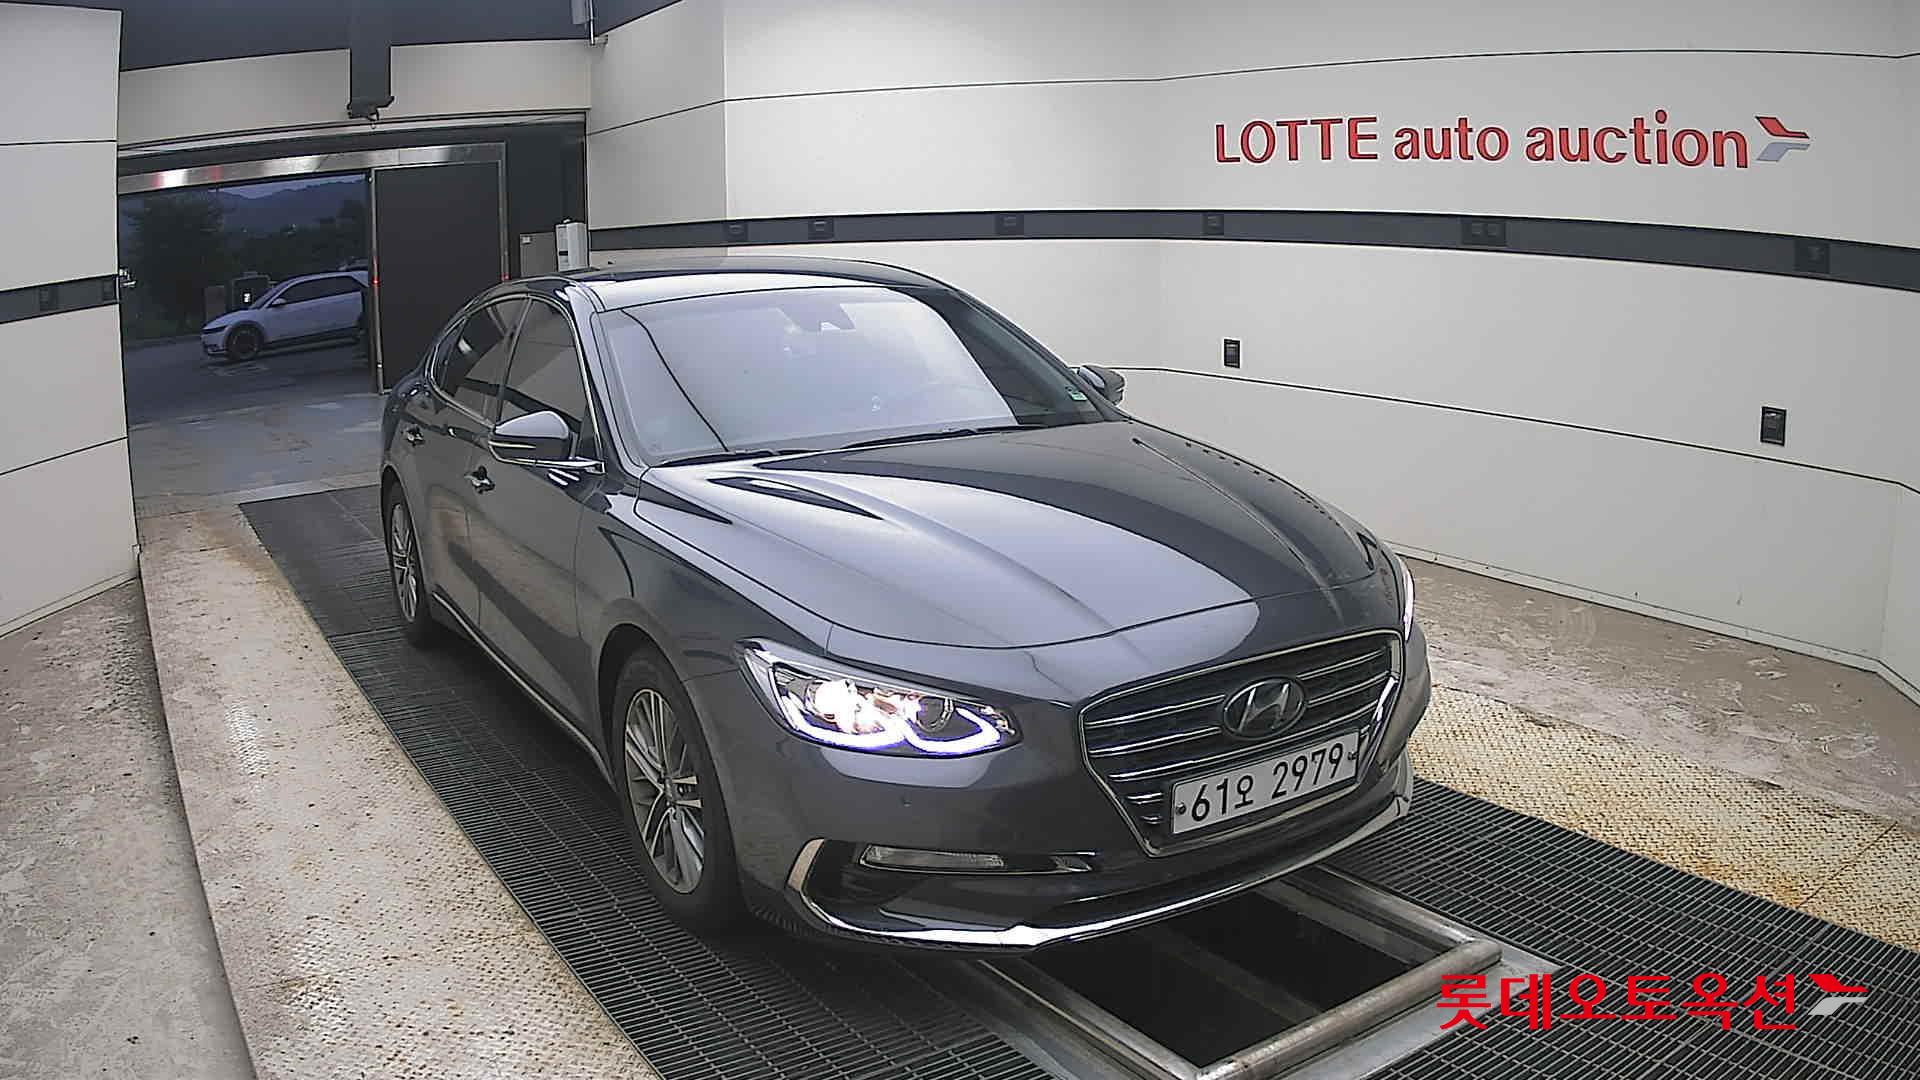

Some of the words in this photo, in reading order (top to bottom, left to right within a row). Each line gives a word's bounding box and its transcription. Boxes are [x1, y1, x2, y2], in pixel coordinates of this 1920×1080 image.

[1215, 116, 1378, 164] LOTTE
[1393, 116, 1510, 162] auto
[1525, 109, 1749, 168] auction
[1191, 775, 1254, 822] 61오
[1271, 743, 1344, 799] 2979
